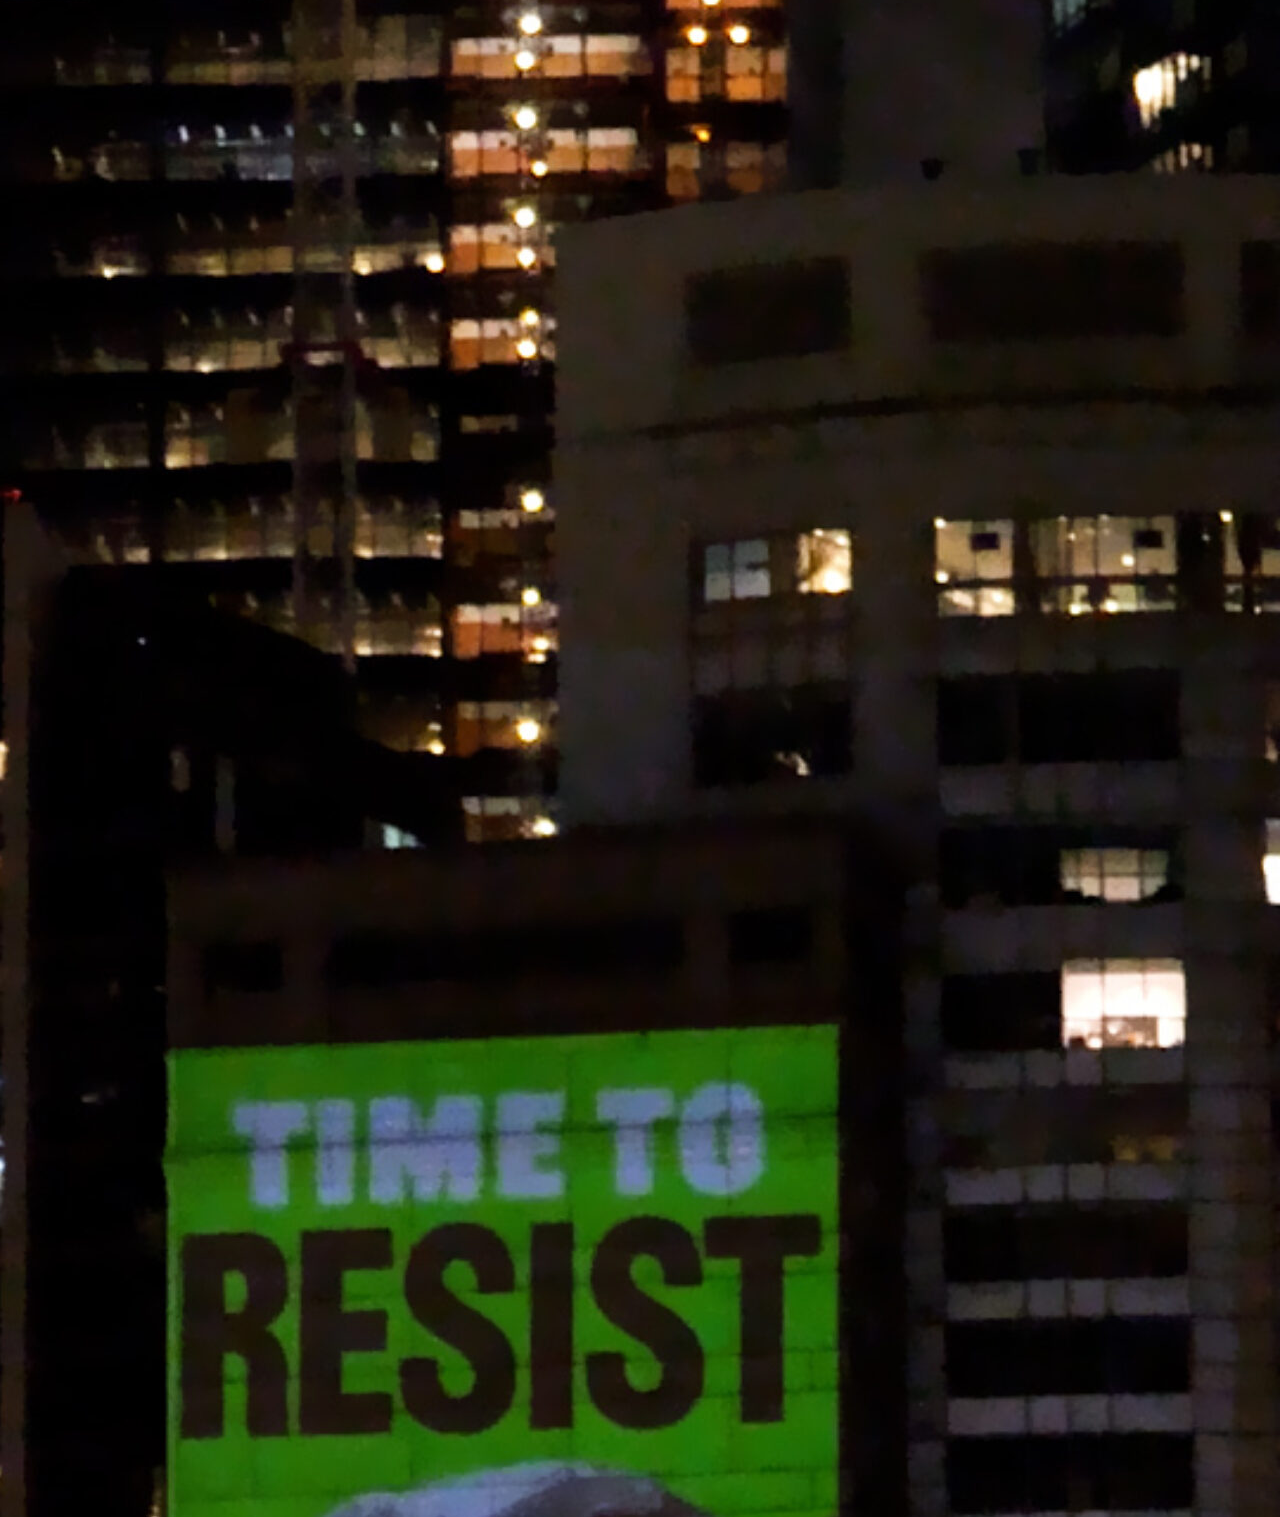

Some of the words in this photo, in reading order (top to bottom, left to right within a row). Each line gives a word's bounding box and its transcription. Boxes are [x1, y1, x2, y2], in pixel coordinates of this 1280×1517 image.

[232, 1090, 566, 1208] TIME
[596, 1080, 765, 1197] TO
[180, 1214, 821, 1439] RESIST
